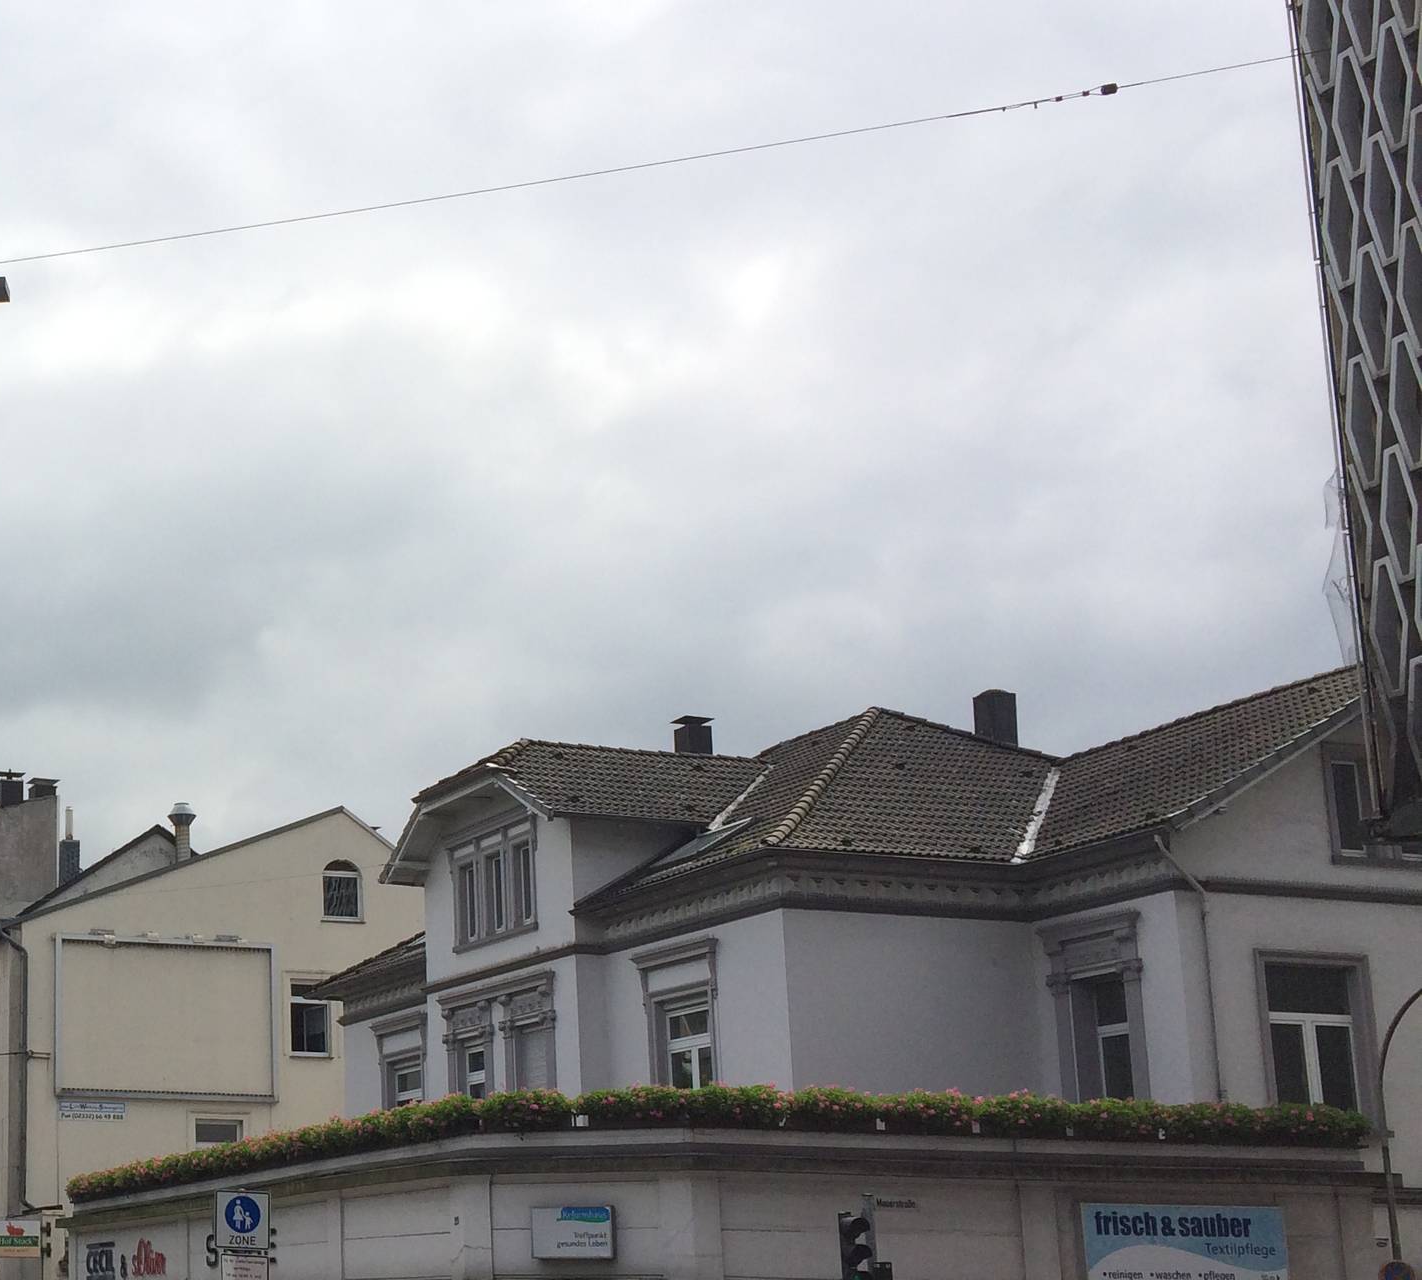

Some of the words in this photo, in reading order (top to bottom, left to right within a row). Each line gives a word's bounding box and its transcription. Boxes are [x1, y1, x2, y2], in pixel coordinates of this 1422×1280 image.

[1094, 1211, 1158, 1236] frisch
[1161, 1214, 1177, 1237] &
[1178, 1213, 1252, 1238] sauber
[228, 1234, 257, 1246] ZONE
[573, 1231, 607, 1241] Treffpunkt
[556, 1240, 587, 1249] gesundes
[588, 1239, 608, 1248] Leben
[1204, 1242, 1277, 1259] Textilpflege
[120, 1253, 128, 1279] &
